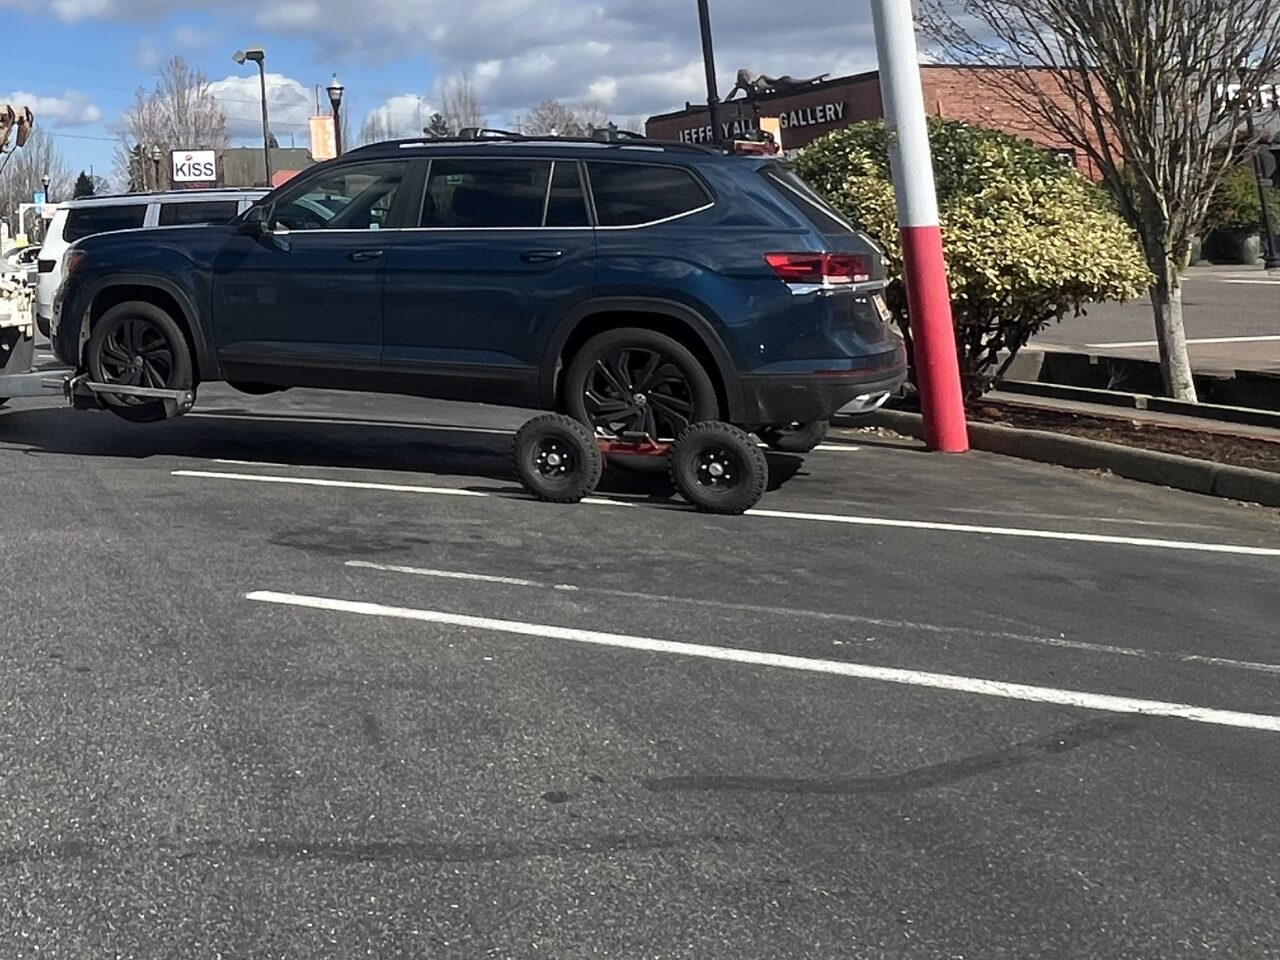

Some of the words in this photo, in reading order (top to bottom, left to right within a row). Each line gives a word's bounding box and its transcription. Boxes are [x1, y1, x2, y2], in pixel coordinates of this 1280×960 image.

[679, 122, 729, 144] JEFFRY
[779, 102, 845, 129] GALLERY
[175, 162, 214, 178] KISS
